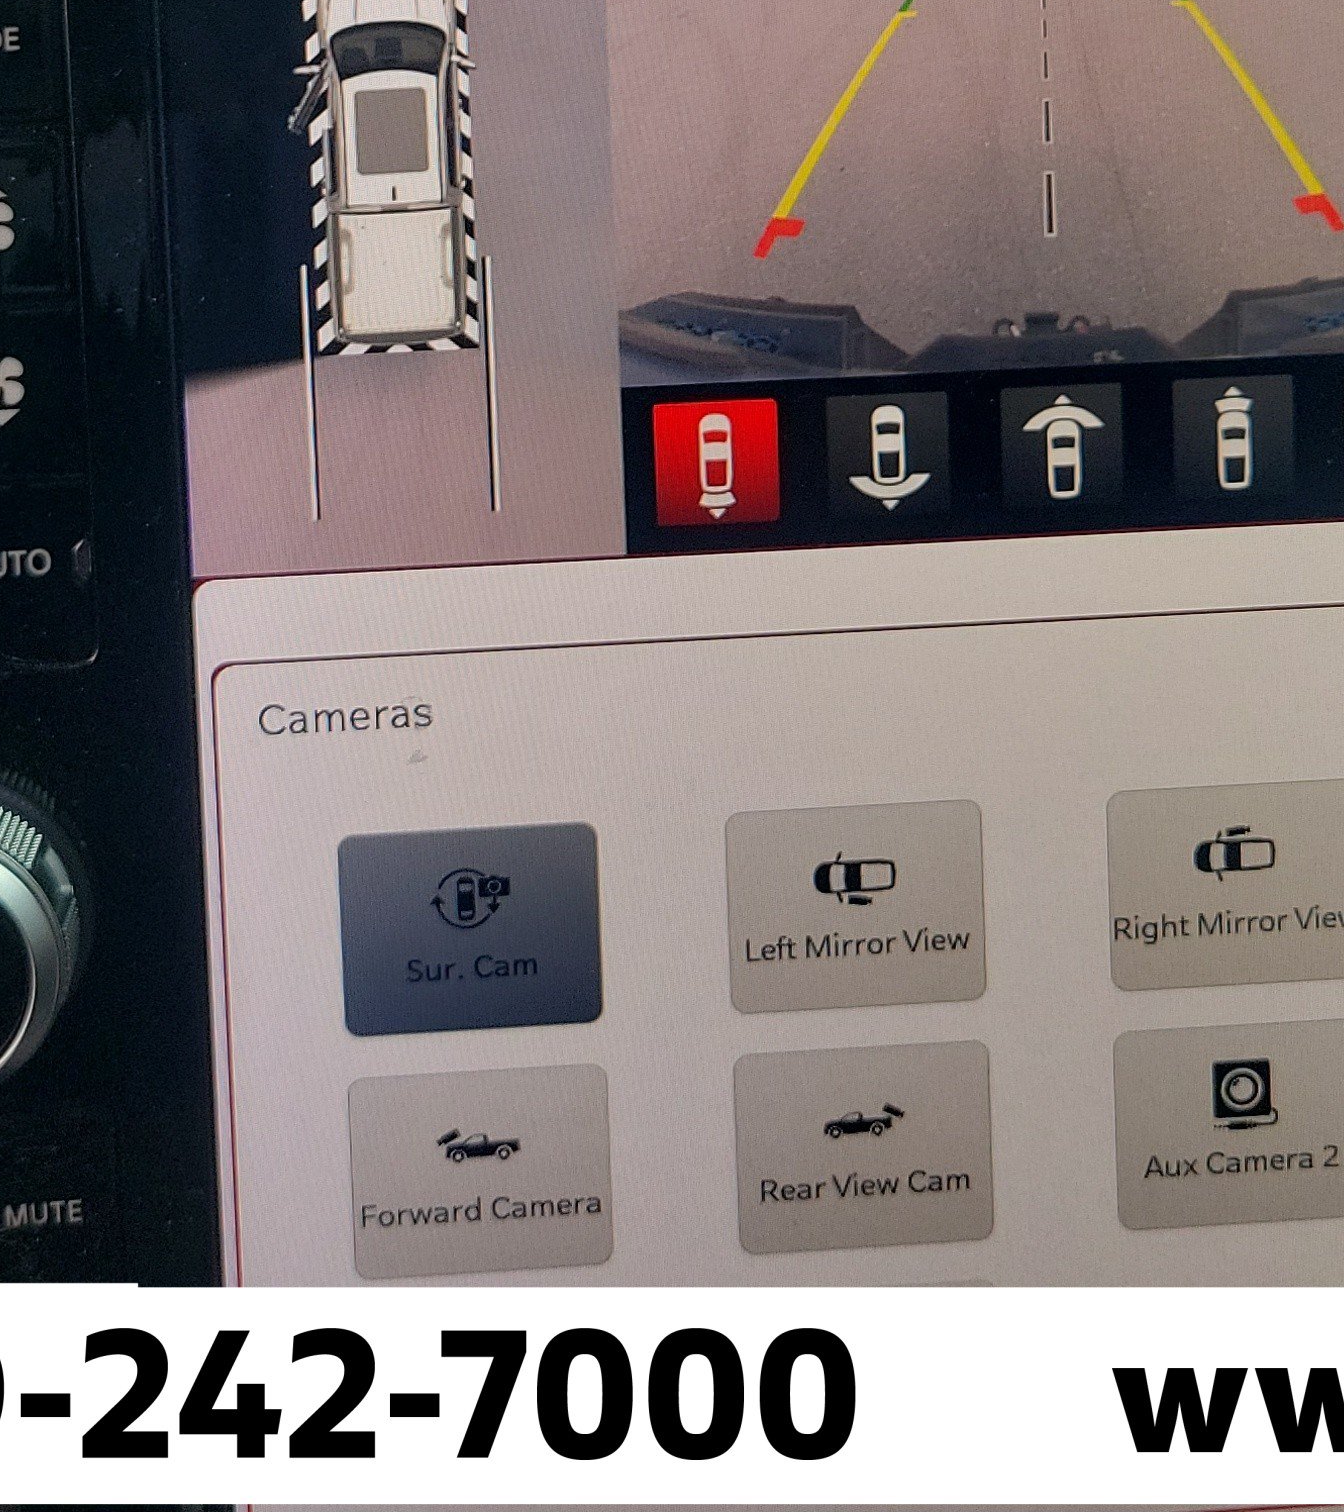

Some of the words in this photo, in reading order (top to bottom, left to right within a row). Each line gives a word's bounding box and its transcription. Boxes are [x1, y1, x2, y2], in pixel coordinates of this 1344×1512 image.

[258, 701, 434, 736] Cameras
[1113, 913, 1190, 946] Right
[1197, 908, 1288, 937] Mirror
[745, 935, 797, 963] Left
[805, 931, 896, 959] Mirror
[902, 927, 970, 955] View
[406, 958, 464, 984] Sur.
[474, 954, 538, 979] Cam
[1144, 1154, 1198, 1179] Aux
[1205, 1148, 1314, 1176] Camera
[1322, 1145, 1341, 1168] 2
[760, 1177, 825, 1203] Rear
[830, 1172, 900, 1199] View
[908, 1169, 971, 1195] Cam
[4, 1199, 84, 1228] MUTE
[361, 1196, 483, 1228] Forward
[491, 1191, 603, 1220] Camera
